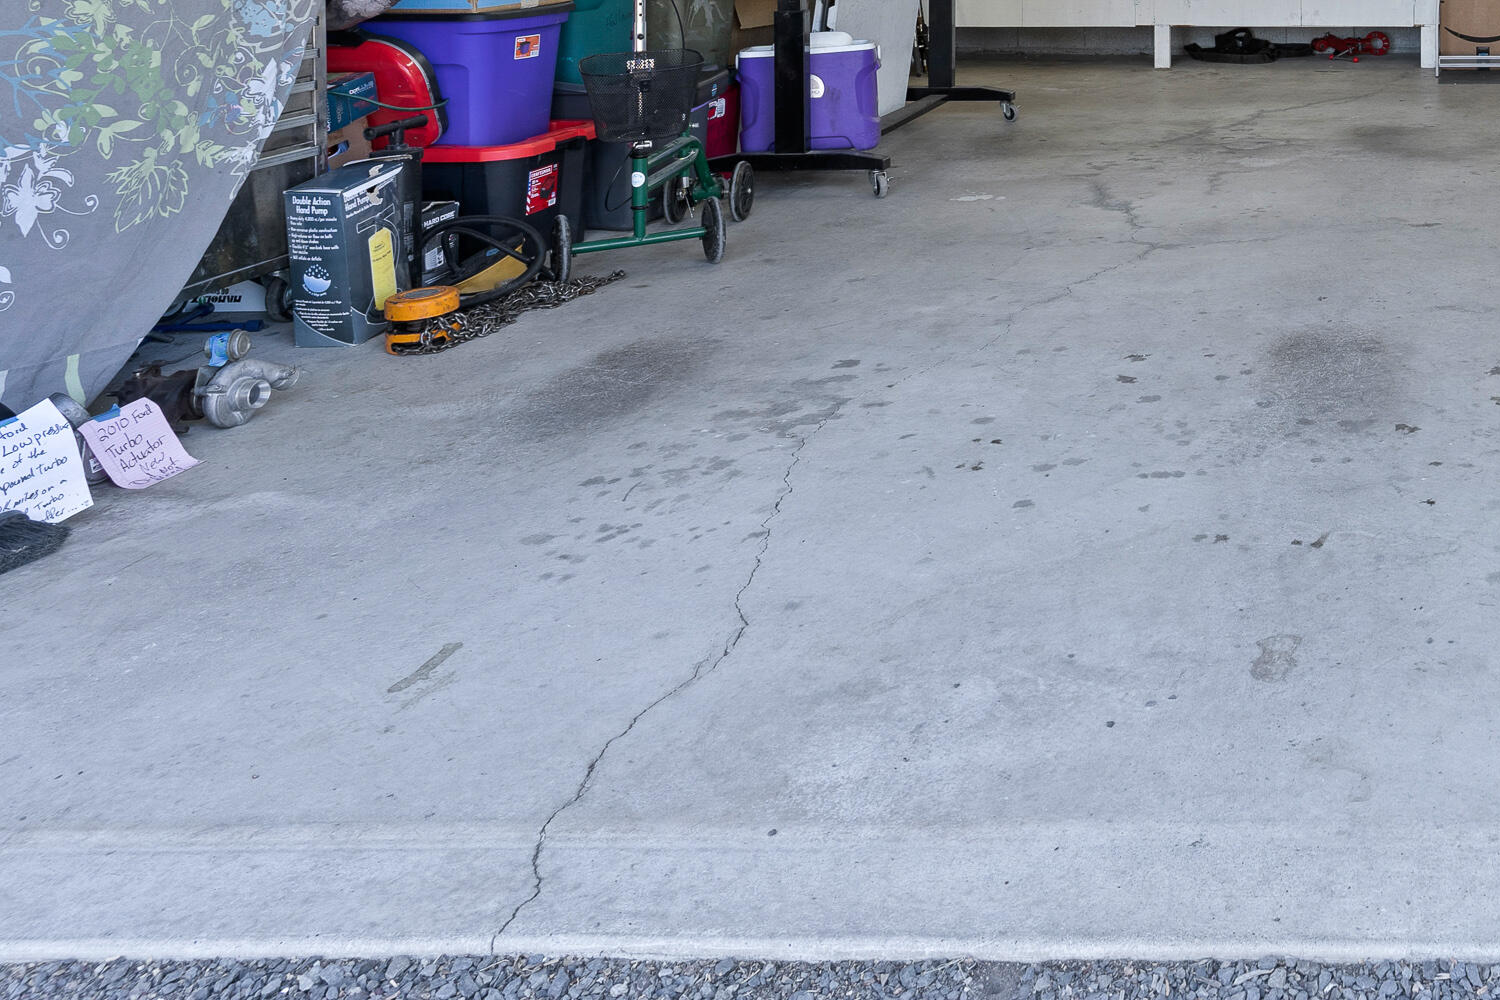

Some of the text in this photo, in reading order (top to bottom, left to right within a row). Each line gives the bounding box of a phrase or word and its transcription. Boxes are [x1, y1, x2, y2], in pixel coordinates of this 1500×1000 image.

[292, 195, 331, 206] Double Action
[344, 200, 357, 212] Hand
[357, 195, 370, 207] Pump
[296, 205, 328, 216] Hand Pump
[97, 403, 153, 442] 2010 Ford
[2, 437, 33, 457] Low
[28, 448, 47, 459] the
[105, 432, 143, 458] Turbo
[119, 434, 167, 473] Actuator
[36, 456, 68, 475] Turbo
[34, 493, 64, 510] Turbo
